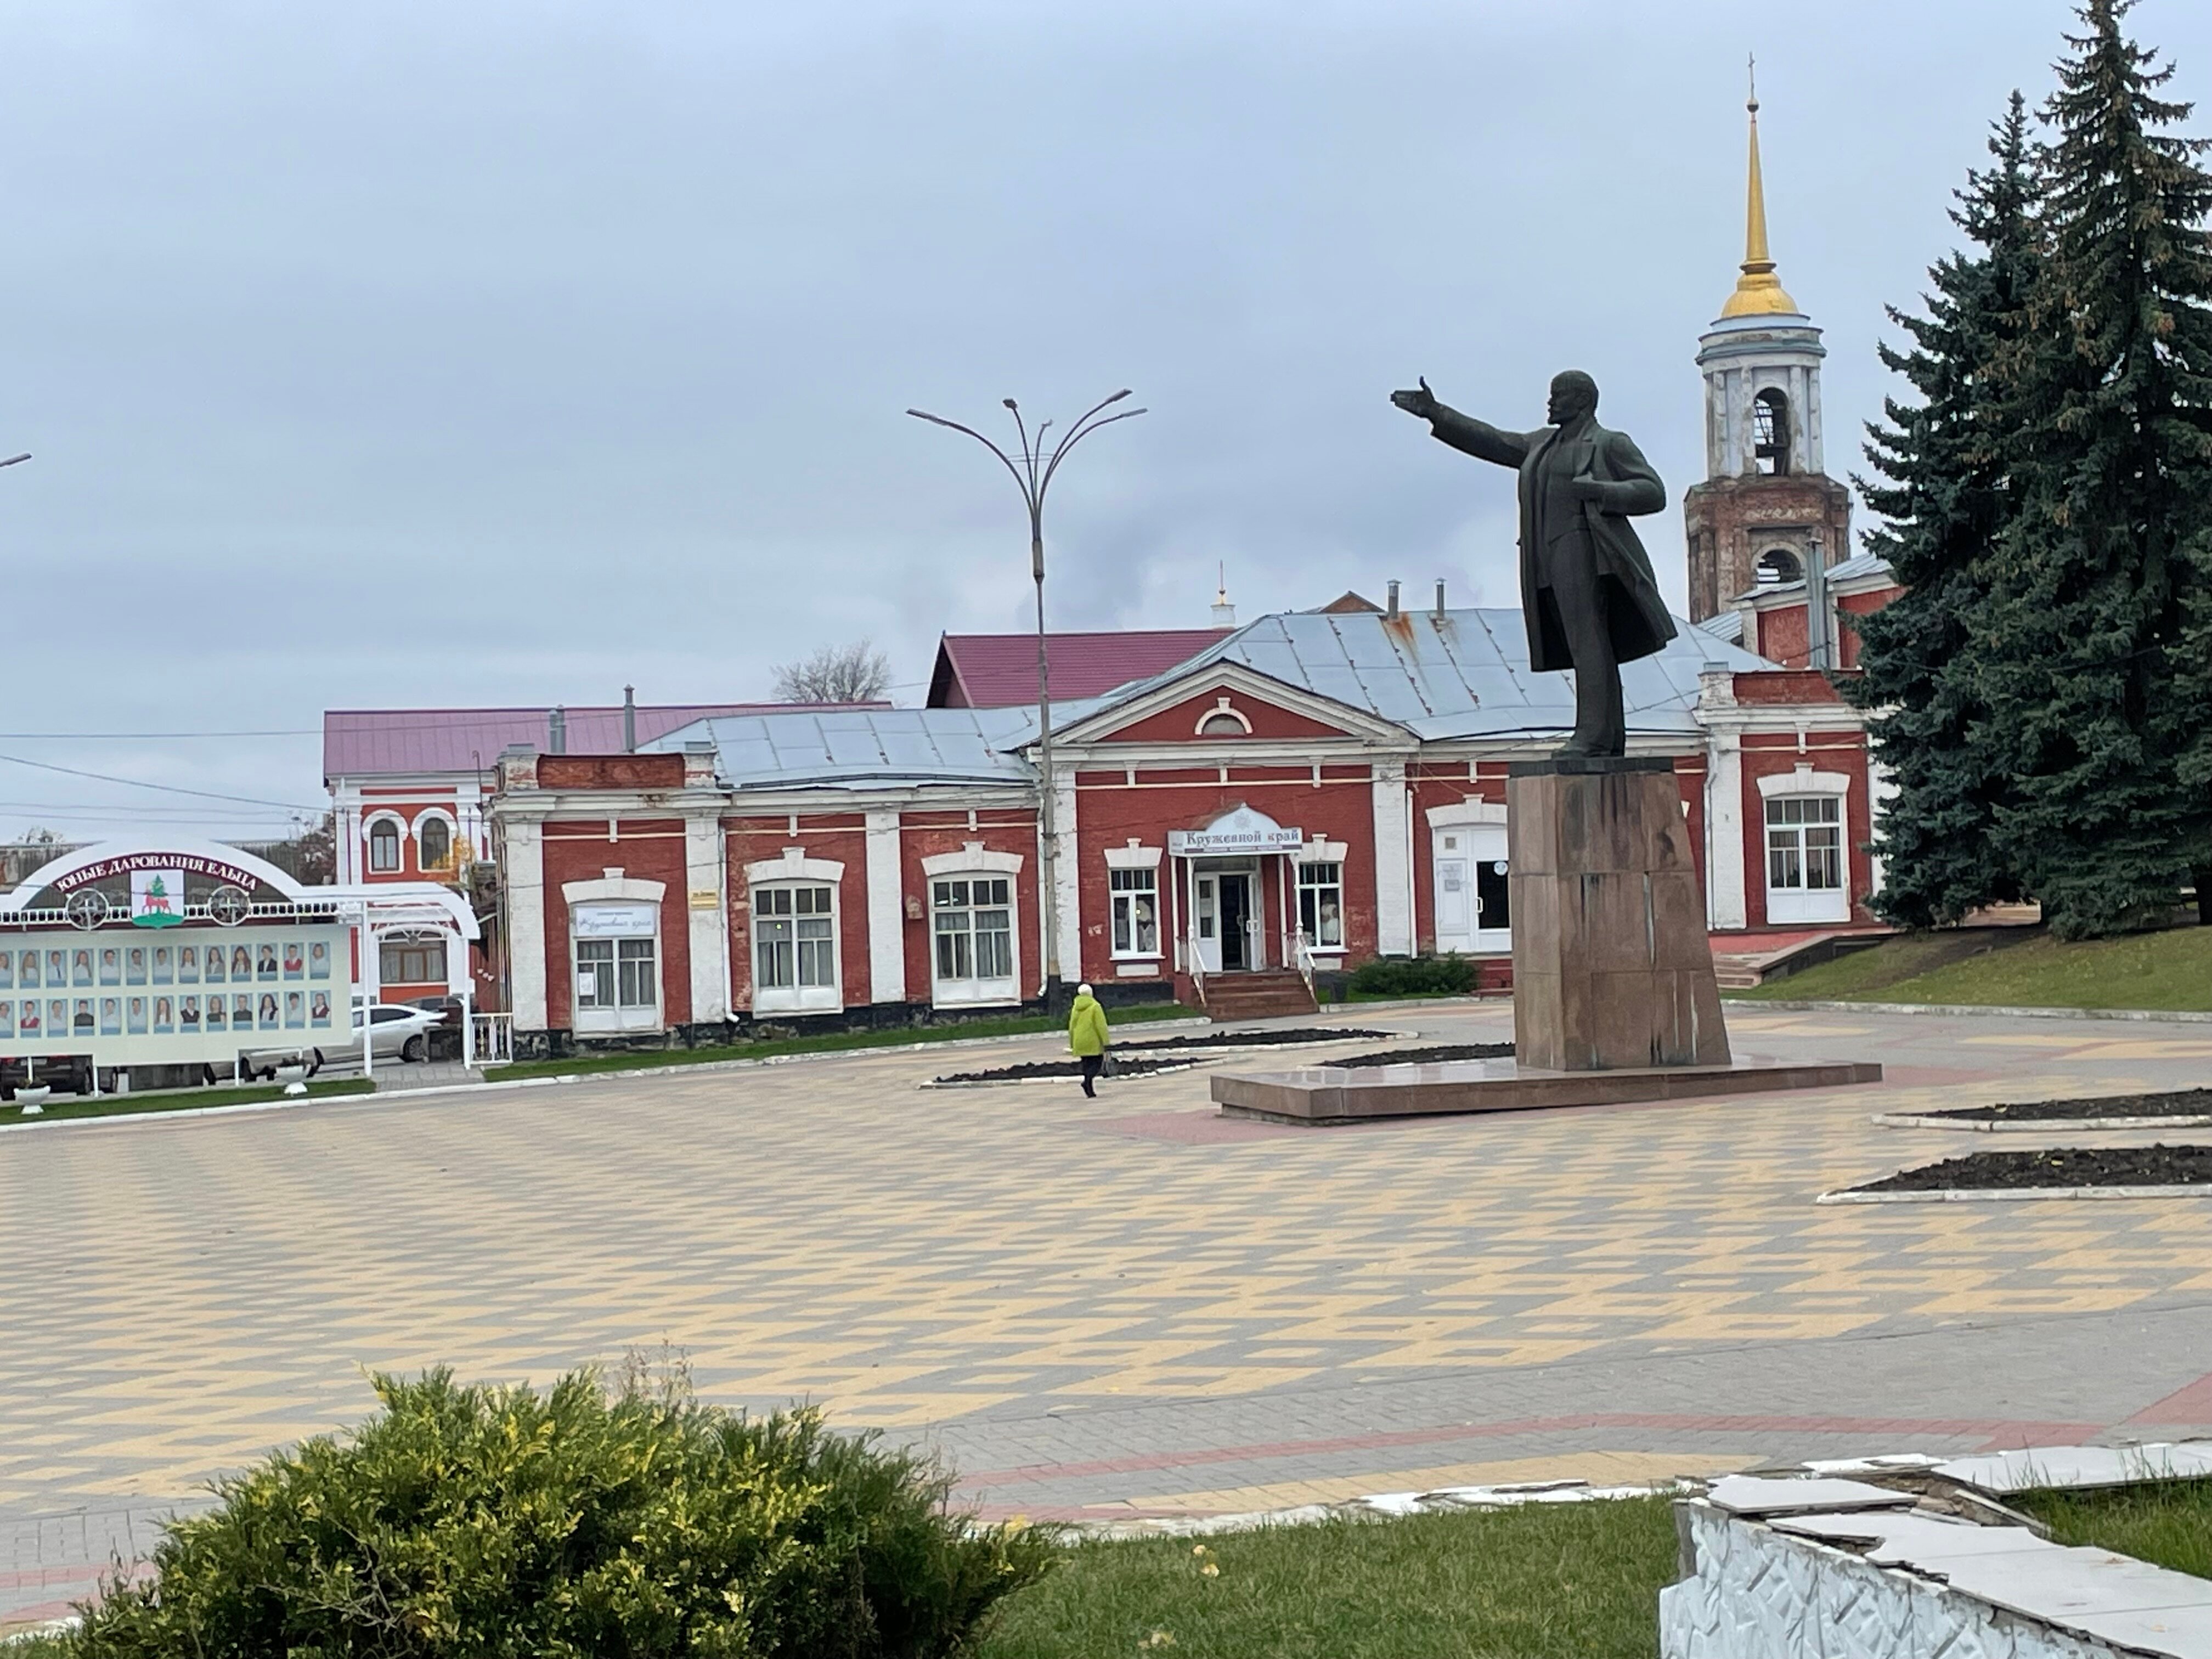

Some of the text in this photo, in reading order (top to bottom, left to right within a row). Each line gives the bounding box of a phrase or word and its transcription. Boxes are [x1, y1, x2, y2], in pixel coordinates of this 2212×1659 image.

[1186, 830, 1299, 847] Кружевной край
[56, 856, 256, 893] ЮНЫЕ ДАРОВАНИЯ ЕЛЬЦА
